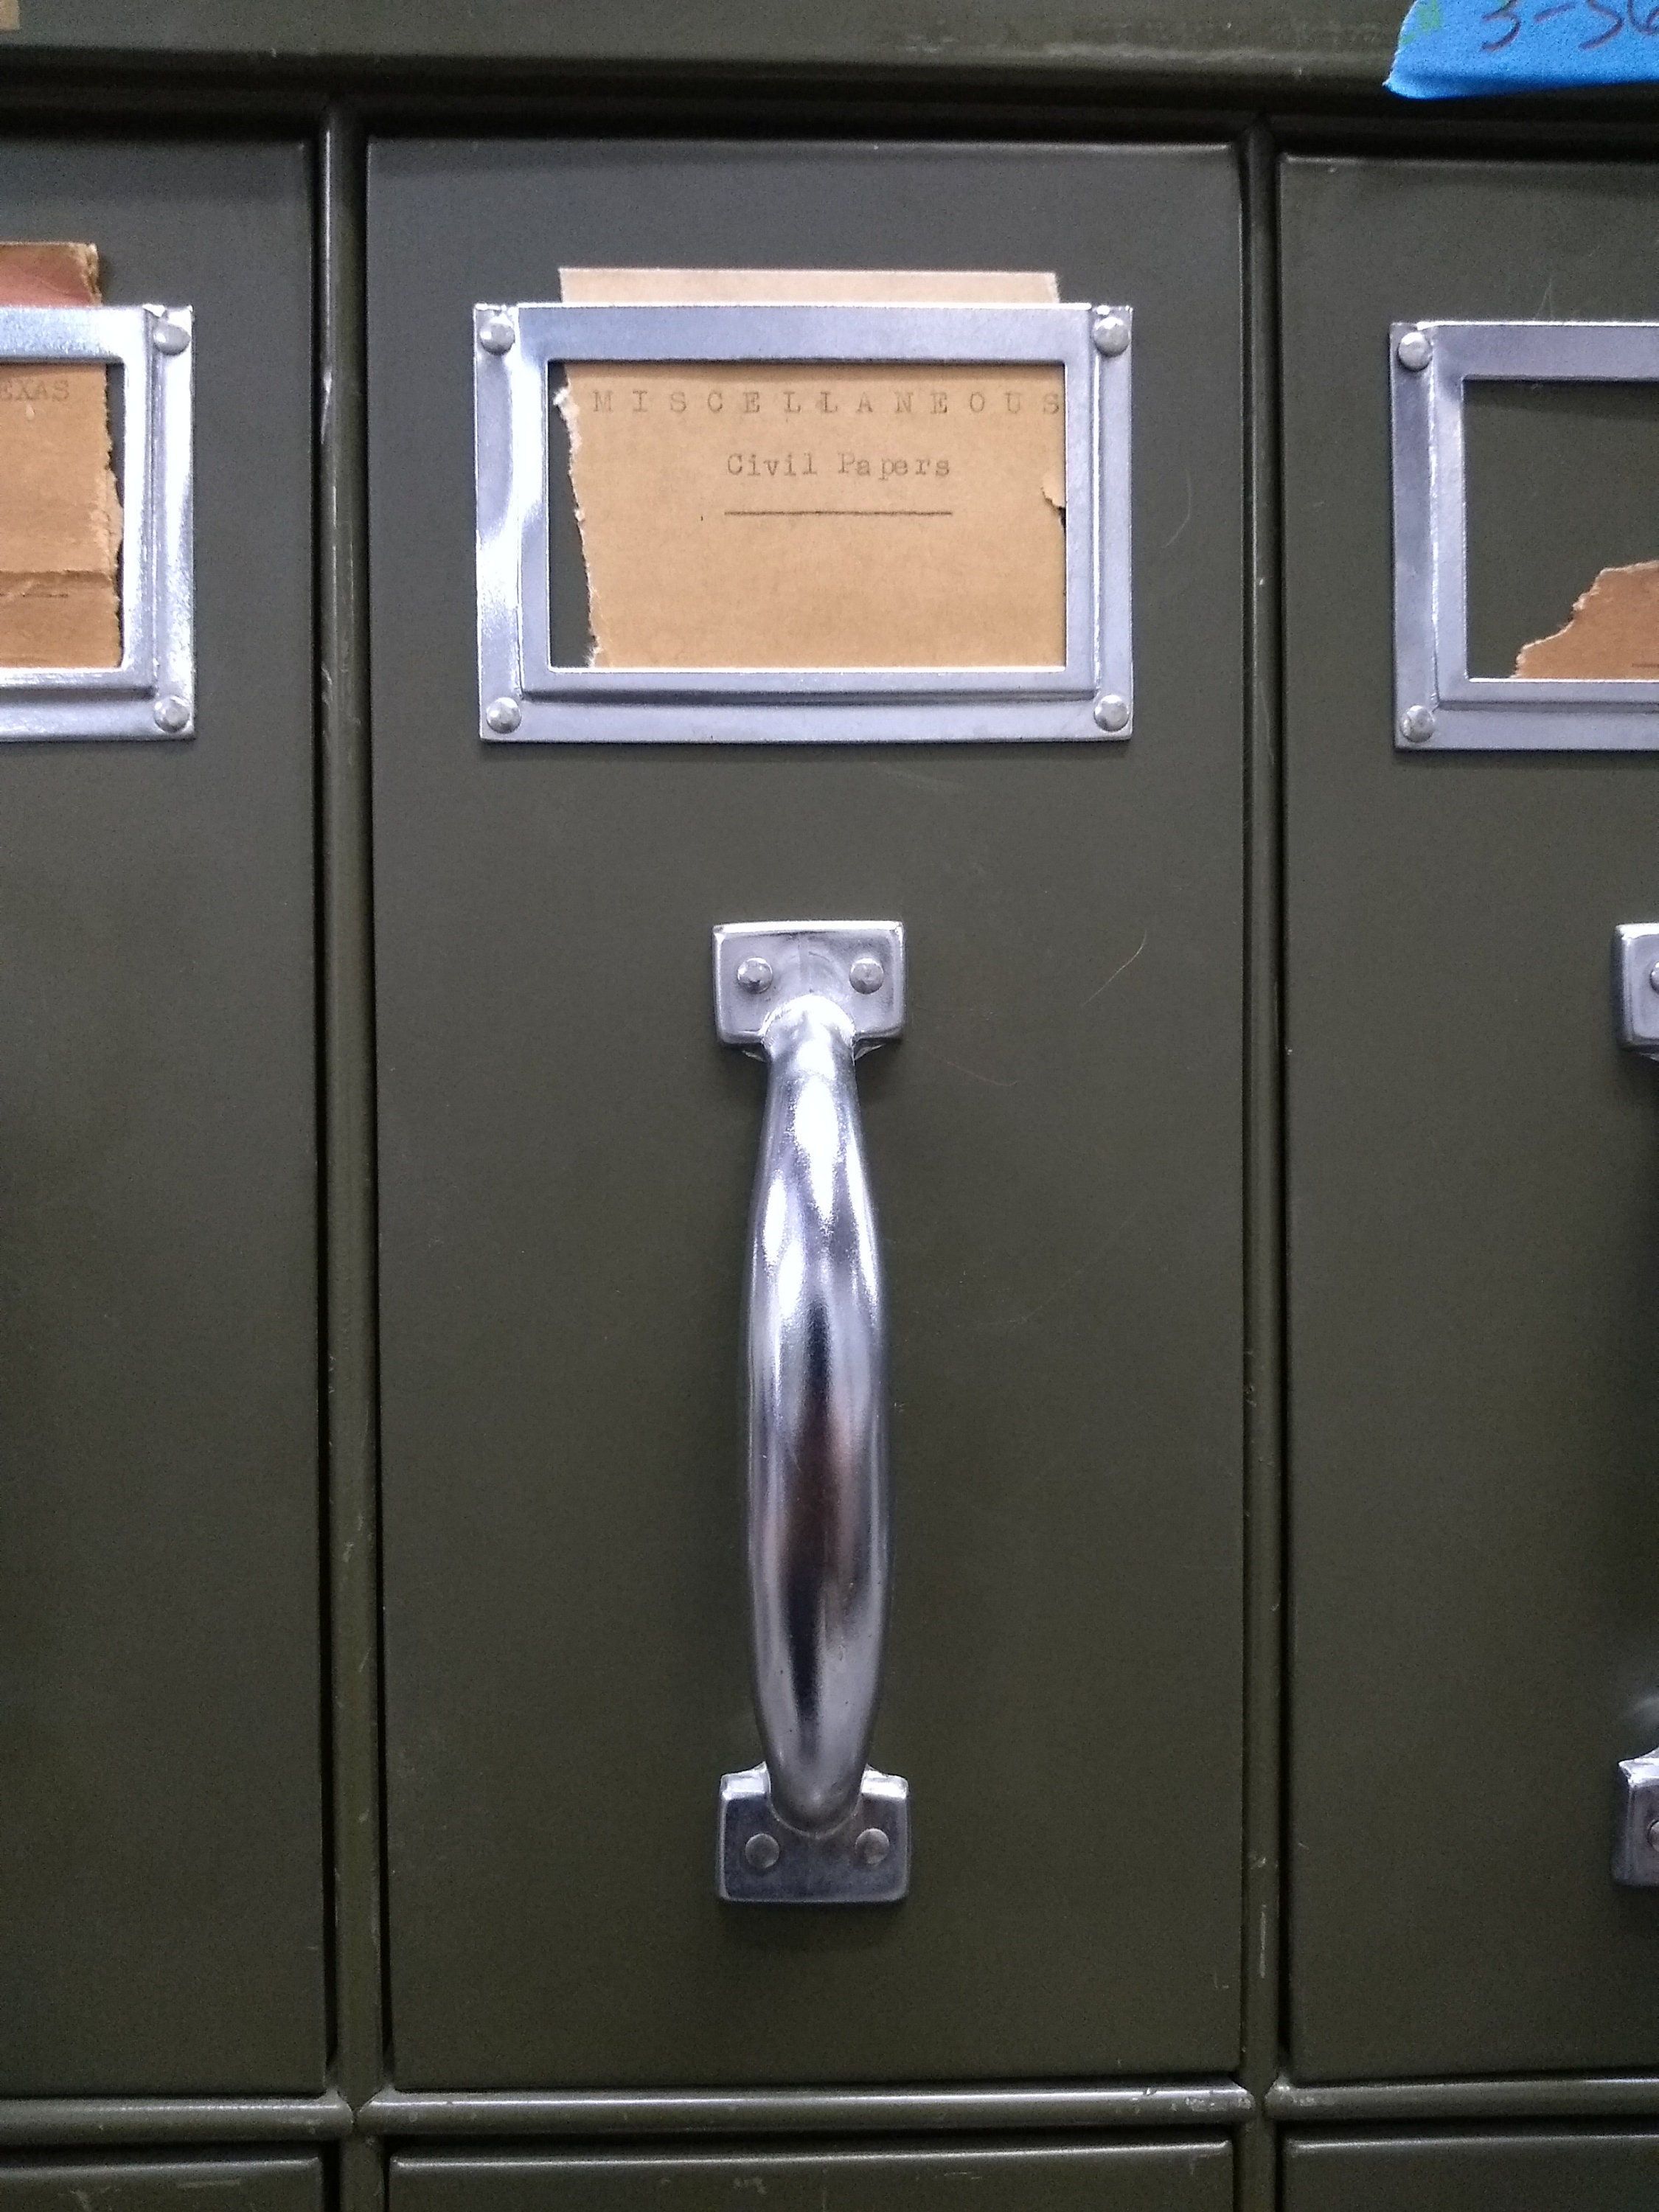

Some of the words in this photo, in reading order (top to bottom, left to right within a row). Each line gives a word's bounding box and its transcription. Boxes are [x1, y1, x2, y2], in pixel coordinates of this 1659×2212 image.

[592, 389, 1060, 415] MISCELLANEOUS
[727, 453, 817, 476] Civil
[838, 452, 950, 481] Papers
